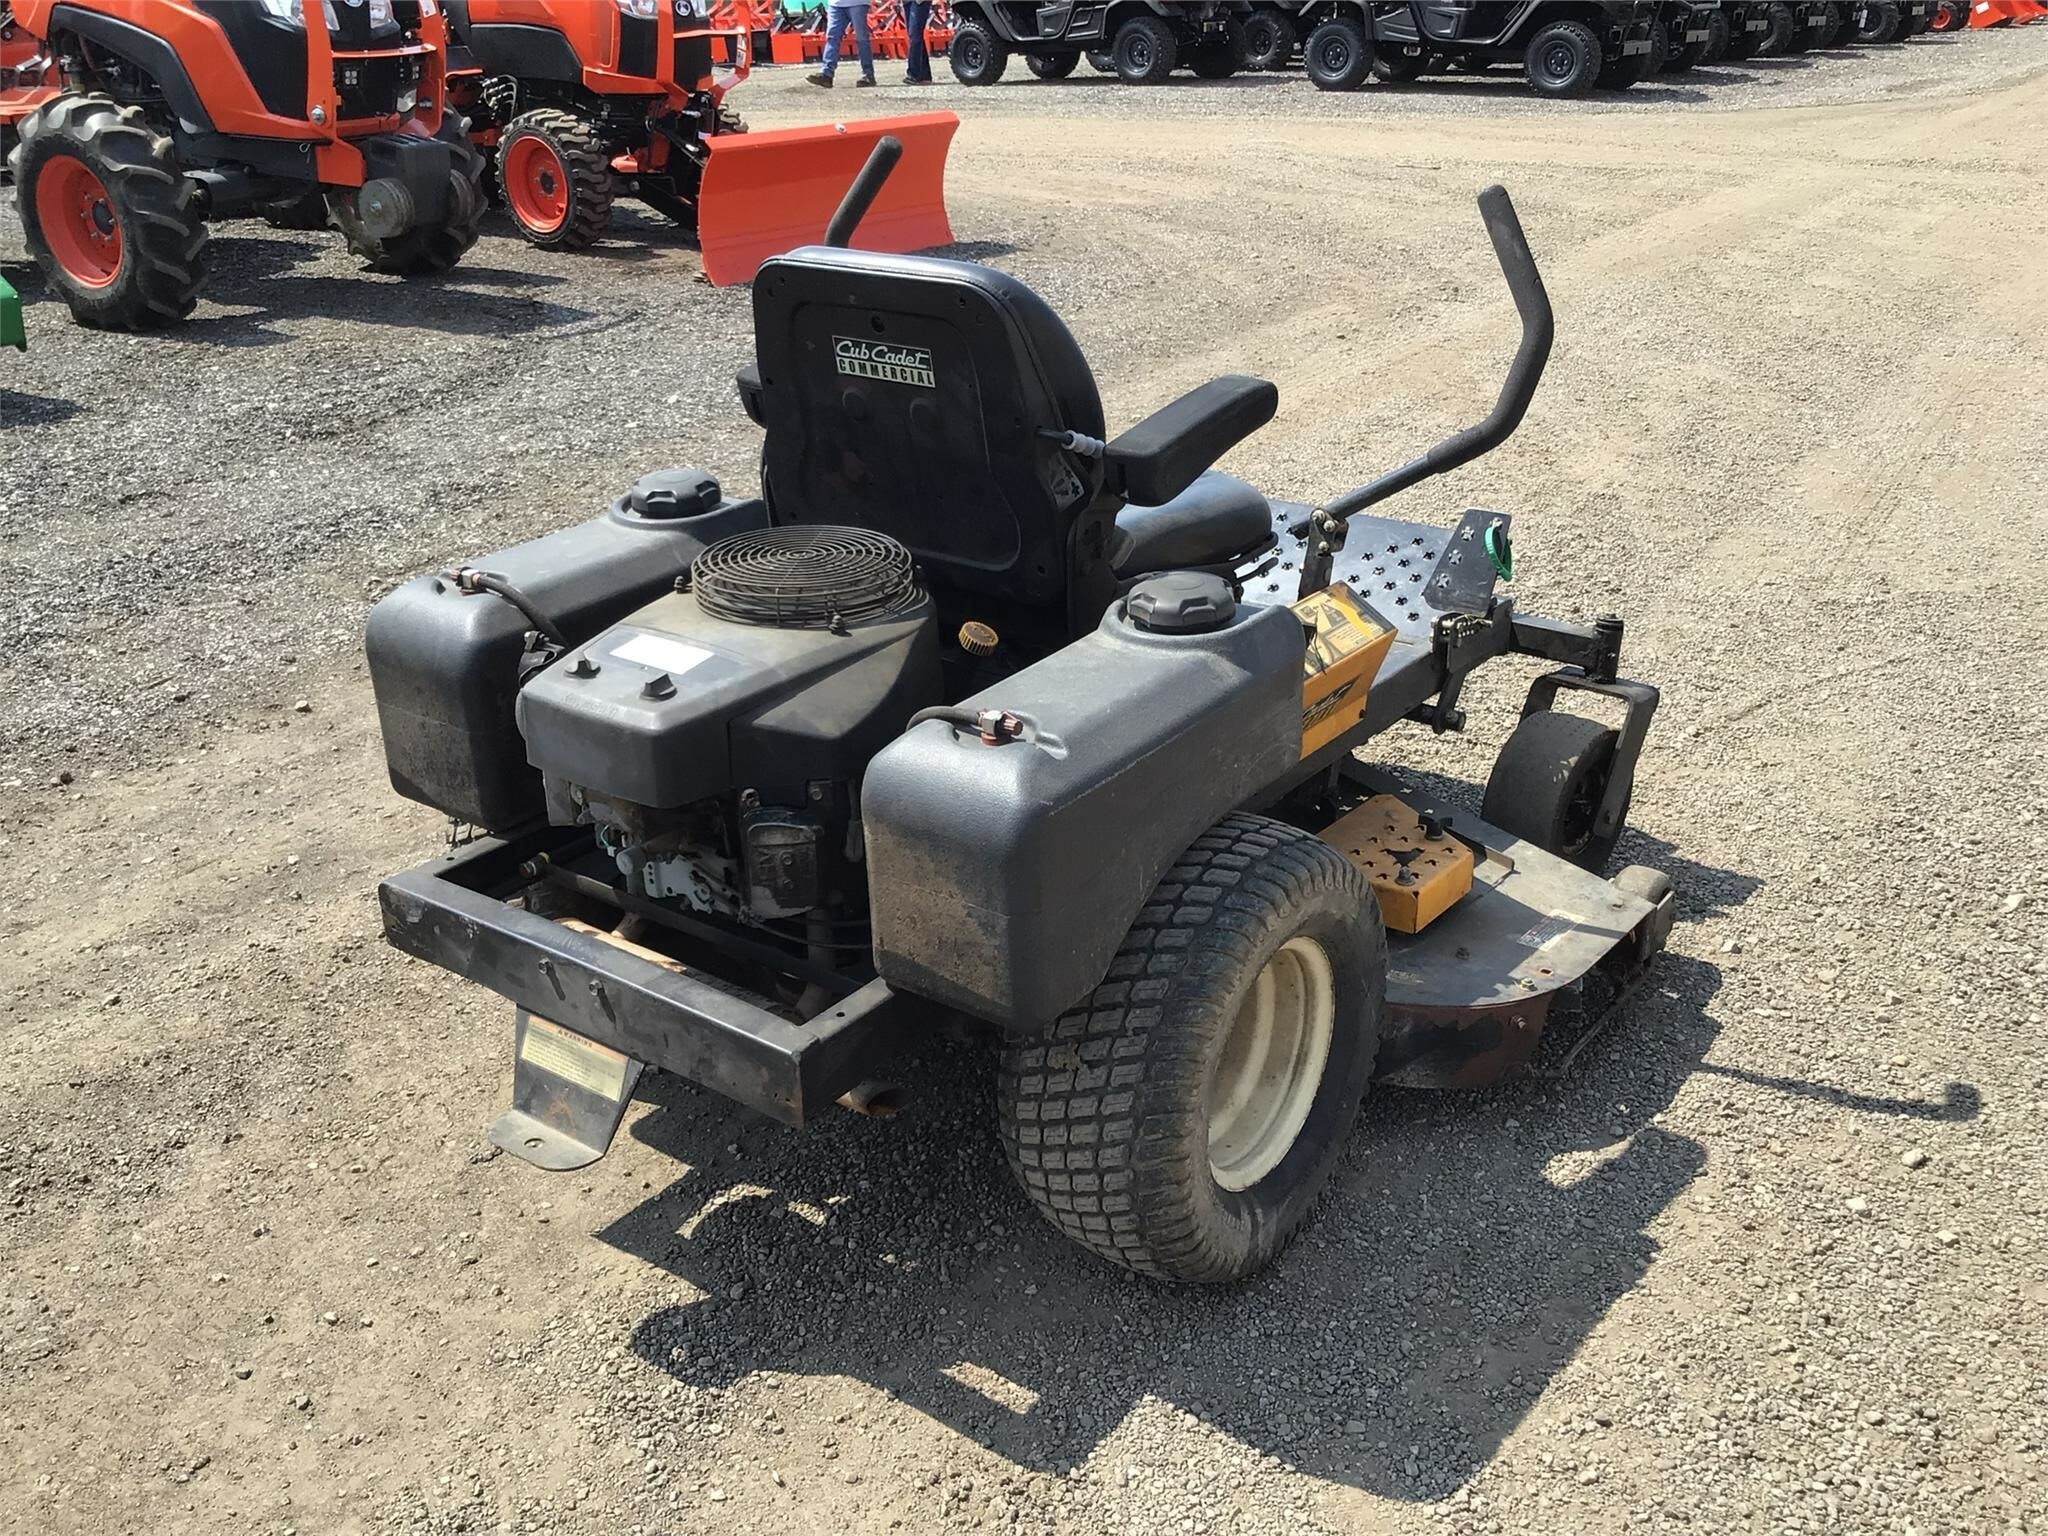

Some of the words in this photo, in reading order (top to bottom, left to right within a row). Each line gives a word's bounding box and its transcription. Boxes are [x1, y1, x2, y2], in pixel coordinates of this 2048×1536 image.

[836, 340, 870, 360] Cub
[871, 345, 930, 369] Cadet
[839, 359, 933, 385] COMMERCIAL
